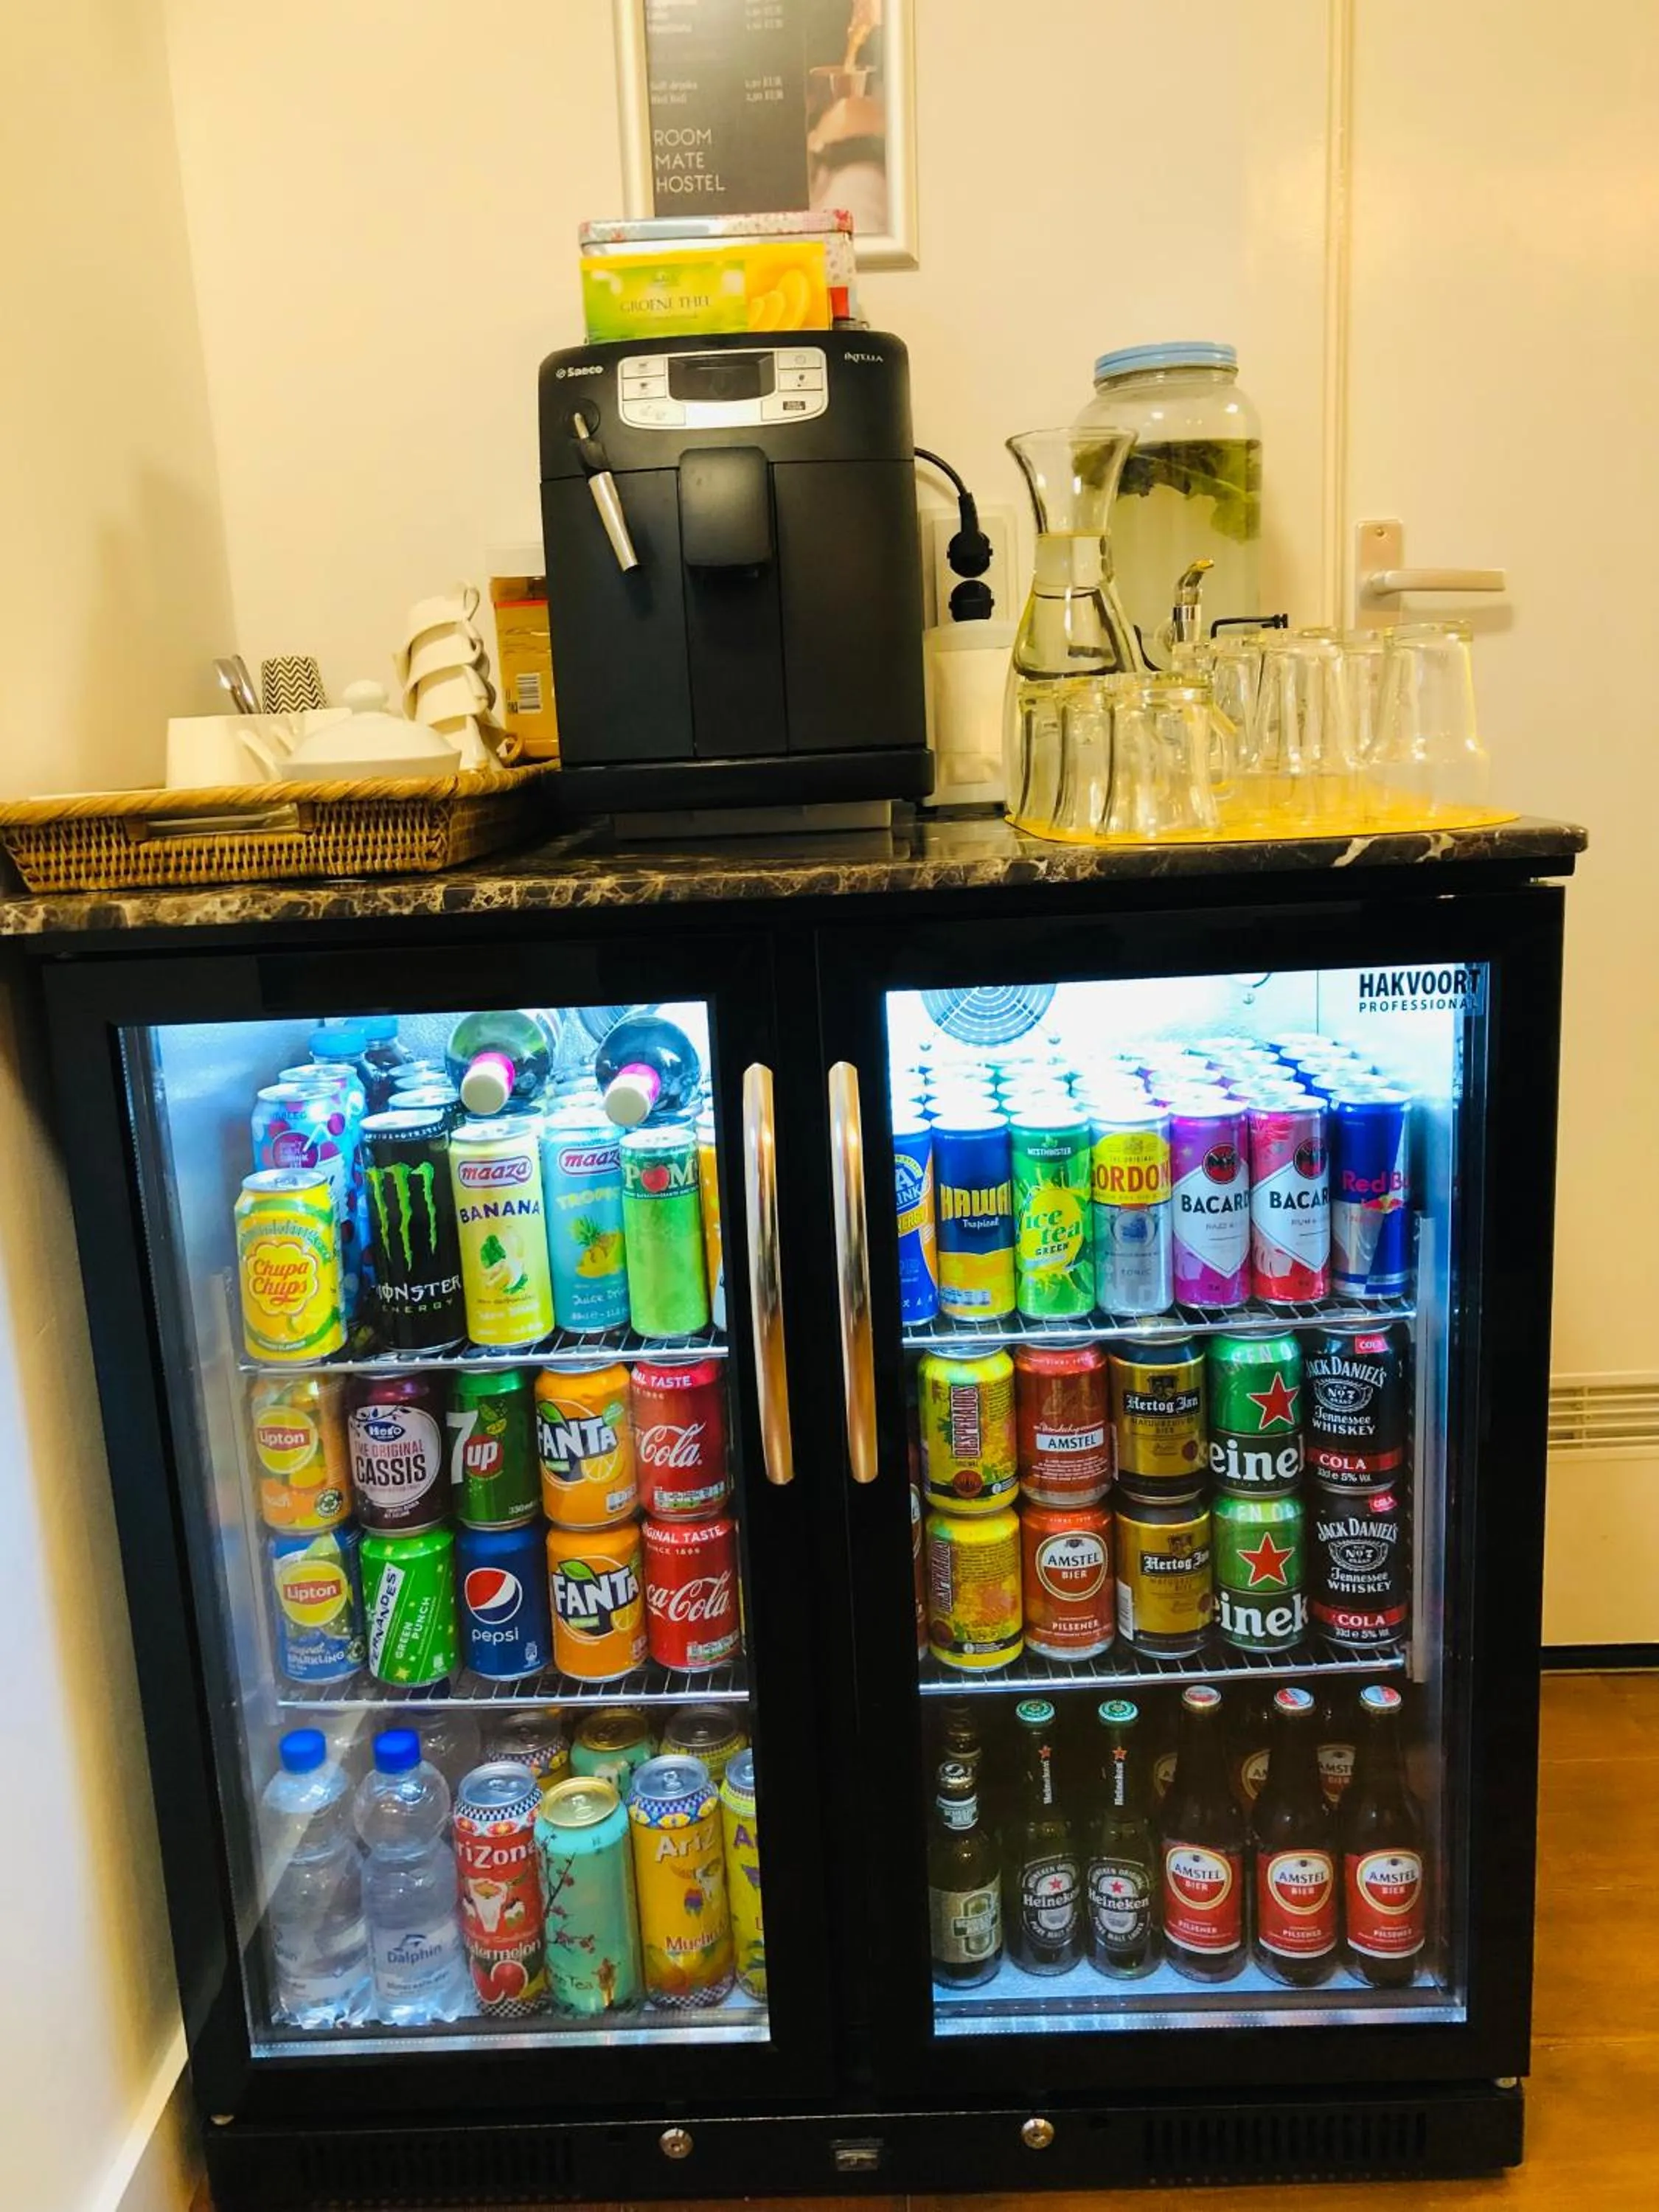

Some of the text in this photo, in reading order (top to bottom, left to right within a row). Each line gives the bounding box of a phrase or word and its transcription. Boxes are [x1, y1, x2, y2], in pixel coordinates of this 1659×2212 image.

[654, 128, 712, 146] ROOM
[655, 152, 704, 170] MATE
[656, 175, 726, 193] HOSTEL
[1360, 970, 1481, 998] HAKVOORT
[462, 1161, 529, 1183] maaza
[1342, 1169, 1386, 1193] Red
[459, 1199, 540, 1224] BANANA
[1041, 1221, 1080, 1245] tea
[1035, 1242, 1068, 1256] GREEN
[253, 1258, 309, 1279] Chupa
[252, 1276, 307, 1306] Chups
[1358, 1339, 1383, 1349] COLA
[1331, 1356, 1387, 1388] DANIEL'S
[651, 1375, 692, 1388] TASTE
[1126, 1394, 1175, 1414] Hertog
[1315, 1405, 1372, 1425] Tennessee
[369, 1425, 402, 1436] Hero
[1312, 1418, 1375, 1436] WHISKEY
[260, 1430, 305, 1447] Lipton
[1047, 1434, 1097, 1450] AMSTEL
[371, 1439, 425, 1458] ORIGINAL
[356, 1453, 427, 1486] CASSIS
[1319, 1453, 1367, 1470] COLA
[684, 1526, 721, 1543] TASTE
[1316, 1517, 1399, 1544] JACK DANIEL'S
[1048, 1552, 1099, 1568] AMSTEL
[1144, 1554, 1192, 1573] Hertog
[1061, 1569, 1088, 1579] BIER
[1331, 1567, 1388, 1582] Tennessee
[286, 1584, 337, 1602] Lipton
[552, 1566, 639, 1615] FANTA
[1327, 1579, 1393, 1594] WHISKEY
[411, 1597, 431, 1640] PUNCH
[1051, 1619, 1099, 1632] PILSENER
[1337, 1613, 1386, 1627] COLA
[394, 1621, 414, 1659] GREEN
[472, 1626, 519, 1646] pepsi
[1175, 1863, 1222, 1880] AMSTEL
[1279, 1870, 1326, 1885] AMSTEL
[1368, 1869, 1416, 1883] AMSTEL
[1185, 1880, 1209, 1892] BIER
[1291, 1887, 1315, 1896] BIER
[1382, 1885, 1405, 1895] BIER
[1088, 1888, 1150, 1910] Heineken
[387, 1944, 442, 1966] Dalphin
